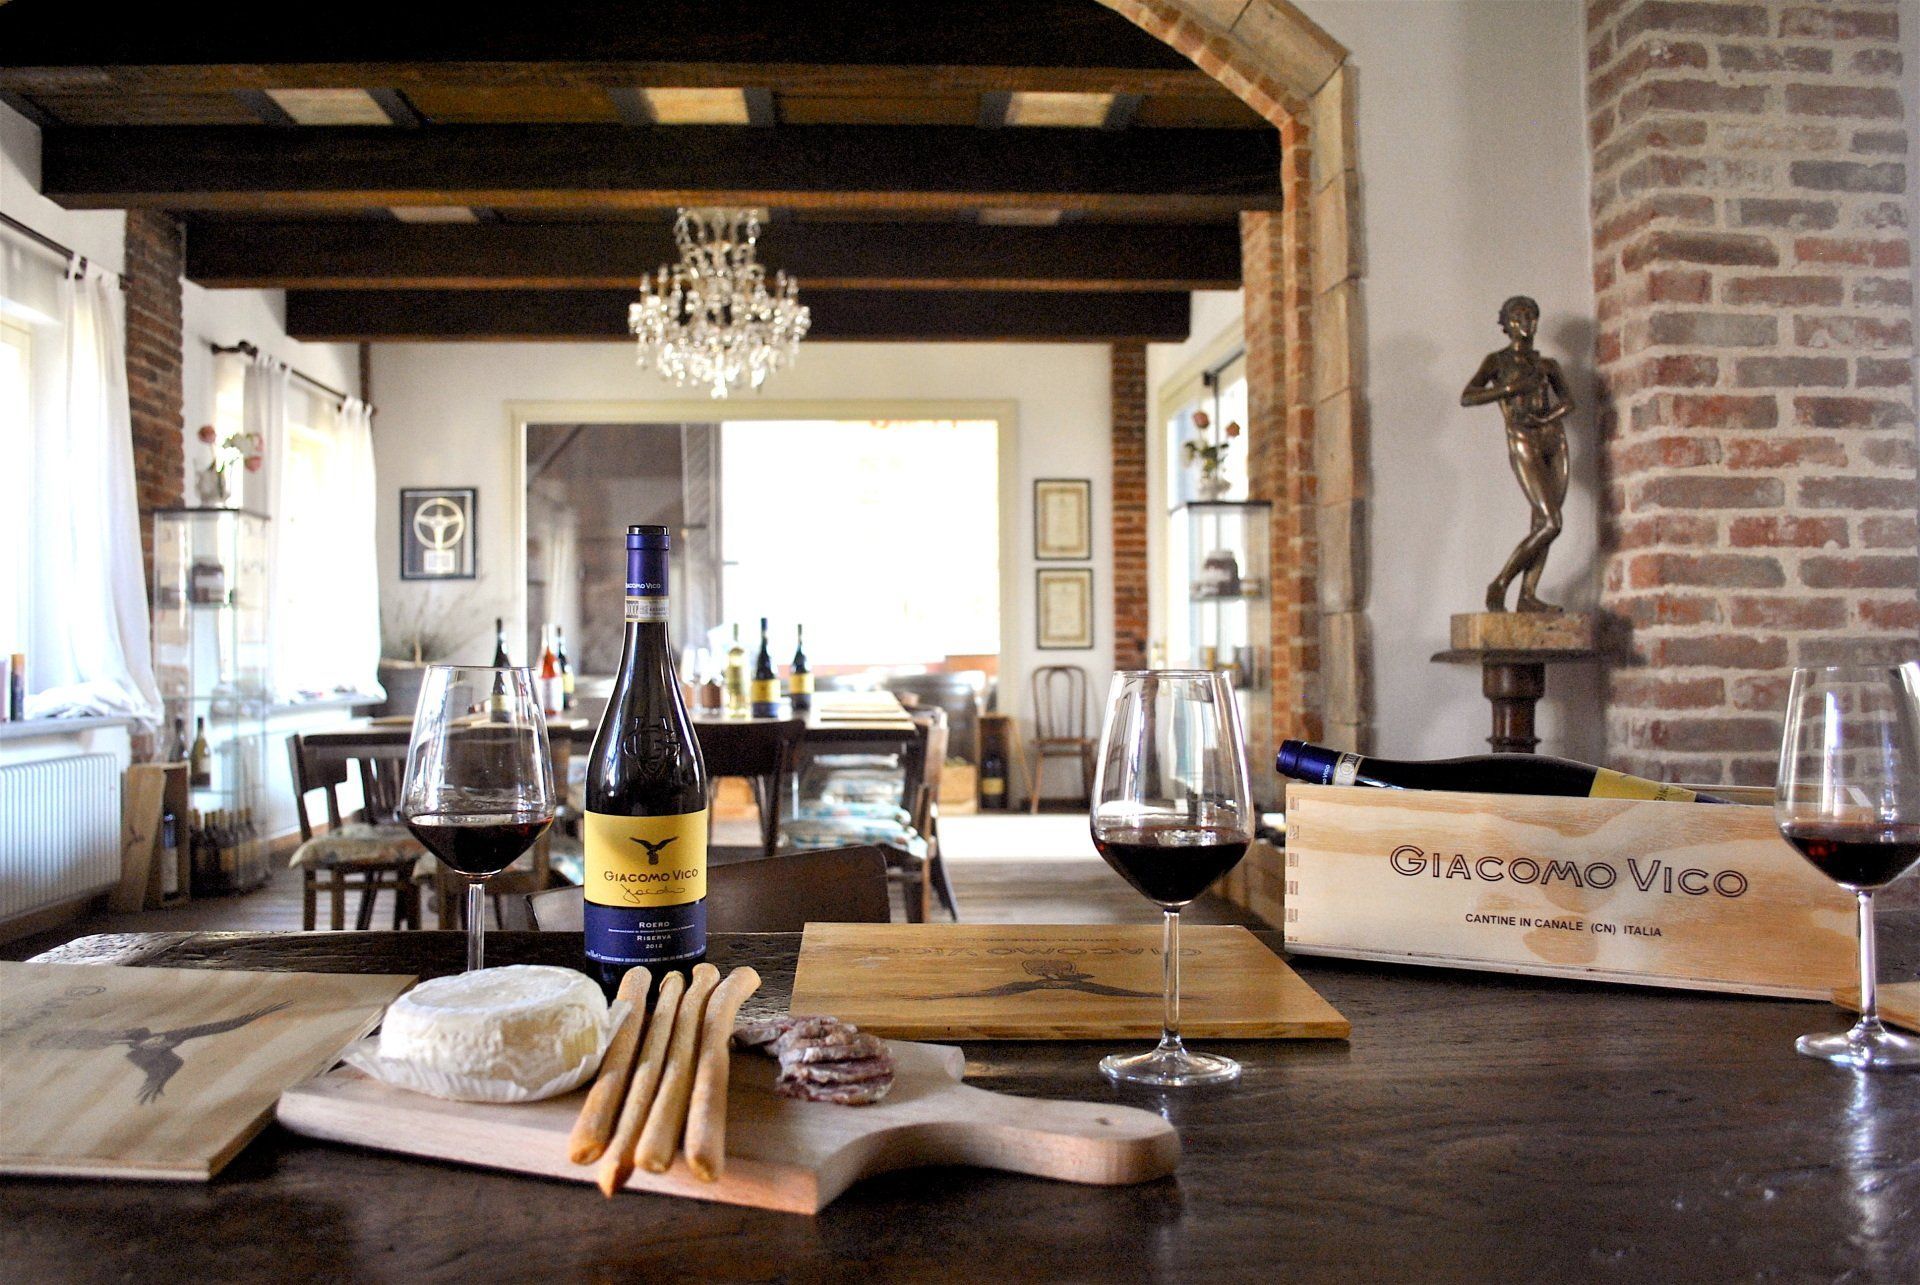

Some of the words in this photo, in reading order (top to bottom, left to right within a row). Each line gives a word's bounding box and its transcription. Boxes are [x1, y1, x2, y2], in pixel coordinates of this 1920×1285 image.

[603, 870, 670, 883] GIACOMO
[673, 868, 699, 881] VICO
[1390, 844, 1617, 889] GIACOMO
[1627, 858, 1748, 898] VICO
[1465, 913, 1516, 926] CANTINE
[1519, 917, 1531, 927] IN
[1534, 918, 1584, 931] CANALE
[1590, 922, 1616, 935] (CN)
[1623, 925, 1662, 937] ITALIA
